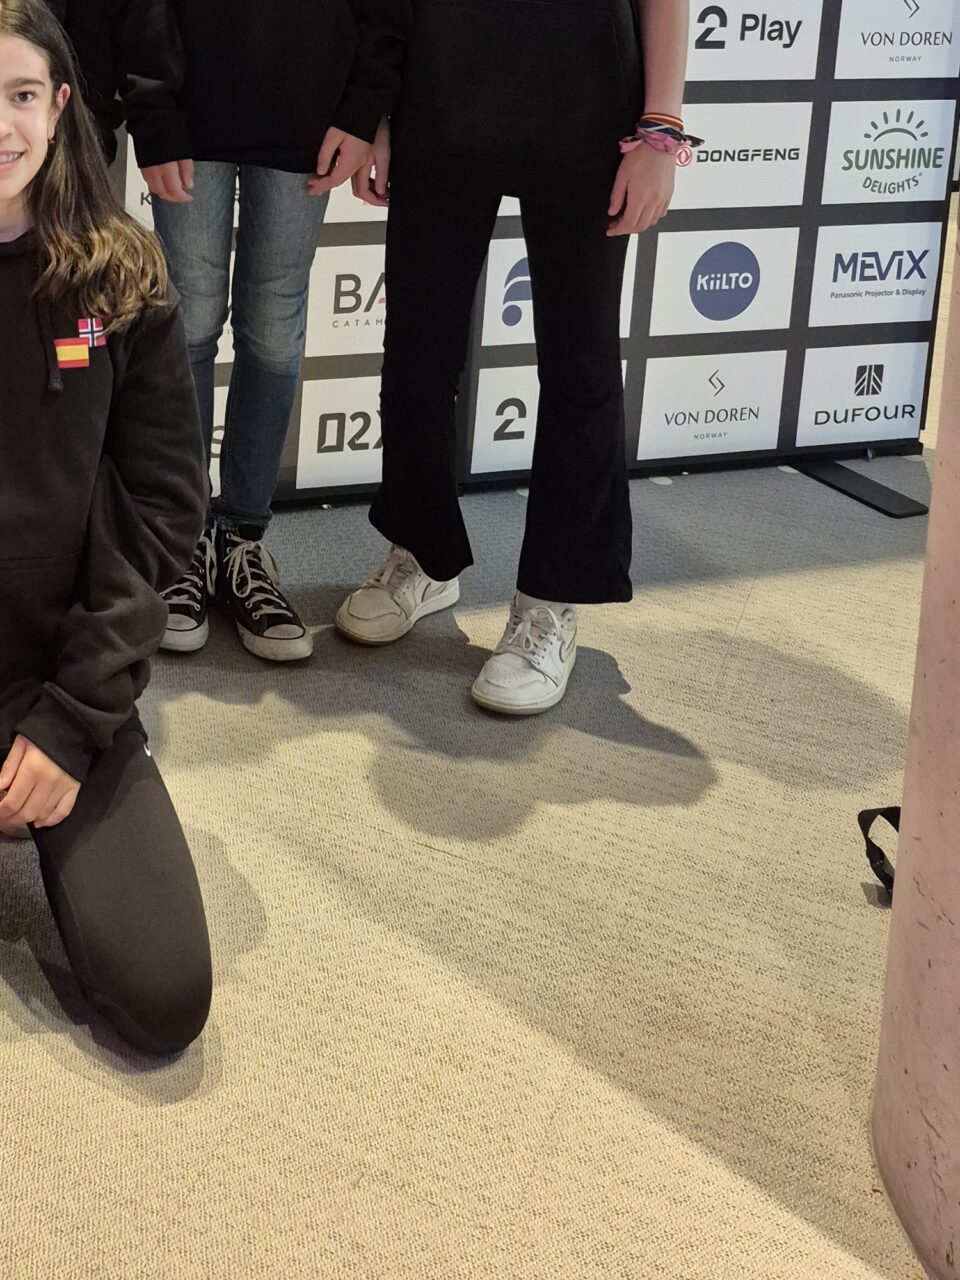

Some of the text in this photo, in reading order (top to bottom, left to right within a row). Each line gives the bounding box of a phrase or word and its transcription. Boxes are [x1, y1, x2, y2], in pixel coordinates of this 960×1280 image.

[695, 5, 802, 49] 2 Play
[861, 31, 952, 46] VON DOREN
[696, 148, 800, 163] DONGFENG
[842, 147, 944, 171] SUNSHINE
[863, 176, 919, 194] DELIGHTS
[830, 291, 863, 299] Panasonic
[865, 289, 893, 298] Projector
[902, 288, 926, 297] Display
[664, 407, 759, 426] VON DOREN
[814, 404, 916, 426] DUFOUR
[693, 432, 728, 440] NORWAY
